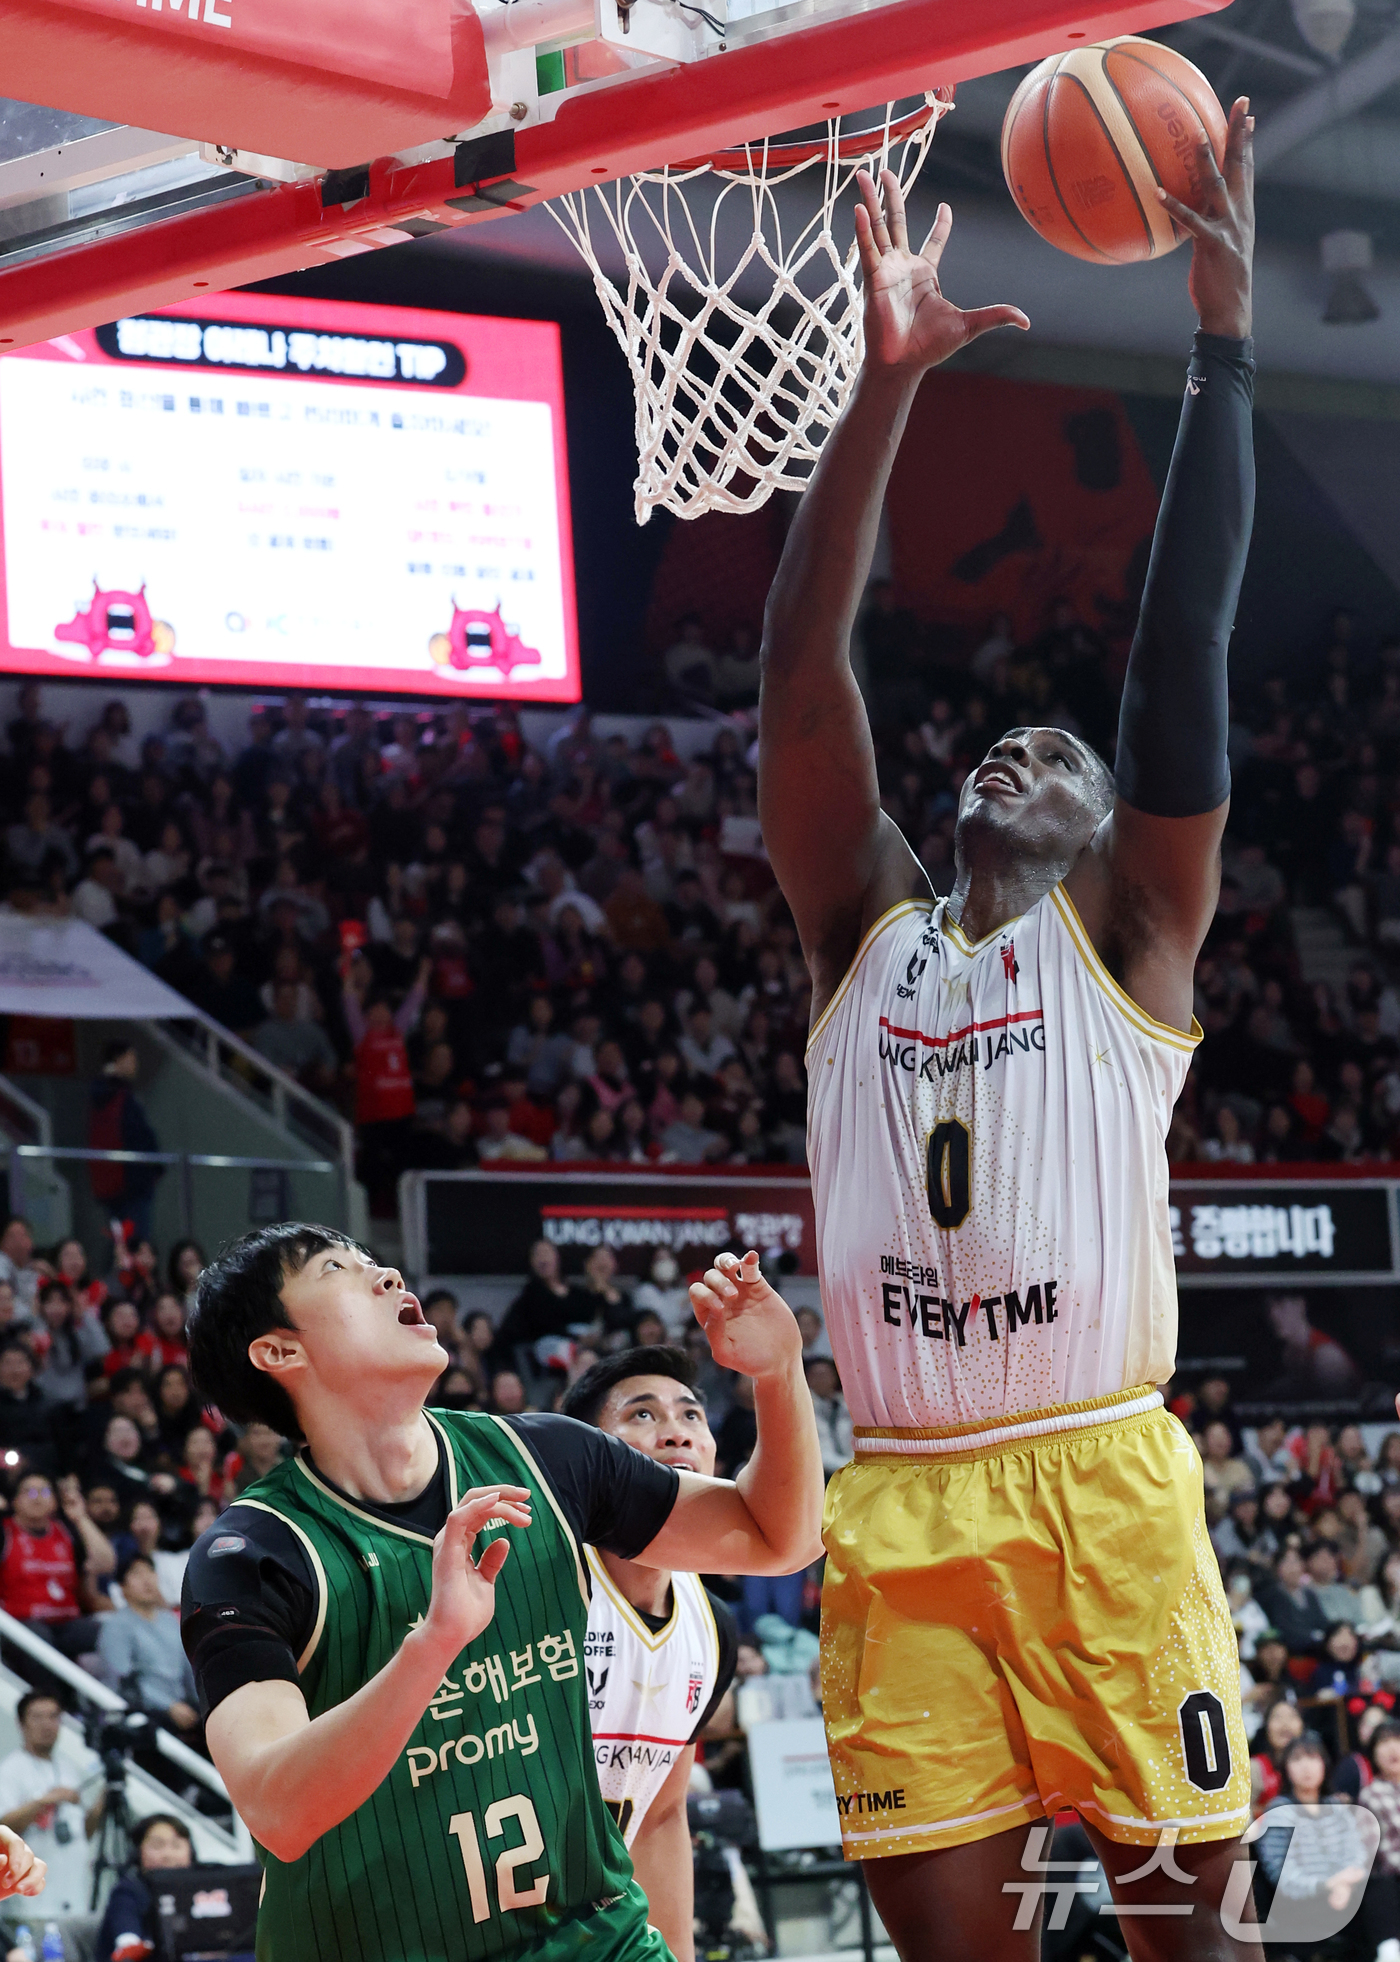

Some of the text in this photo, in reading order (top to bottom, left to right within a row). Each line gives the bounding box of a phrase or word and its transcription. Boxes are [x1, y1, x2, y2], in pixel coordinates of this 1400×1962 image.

[395, 343, 447, 380] TIP
[984, 1024, 1046, 1070] JANG
[924, 1115, 973, 1231] 0
[406, 1713, 539, 1788] promy
[1176, 1688, 1232, 1795] 0
[448, 1793, 550, 1924] 12
